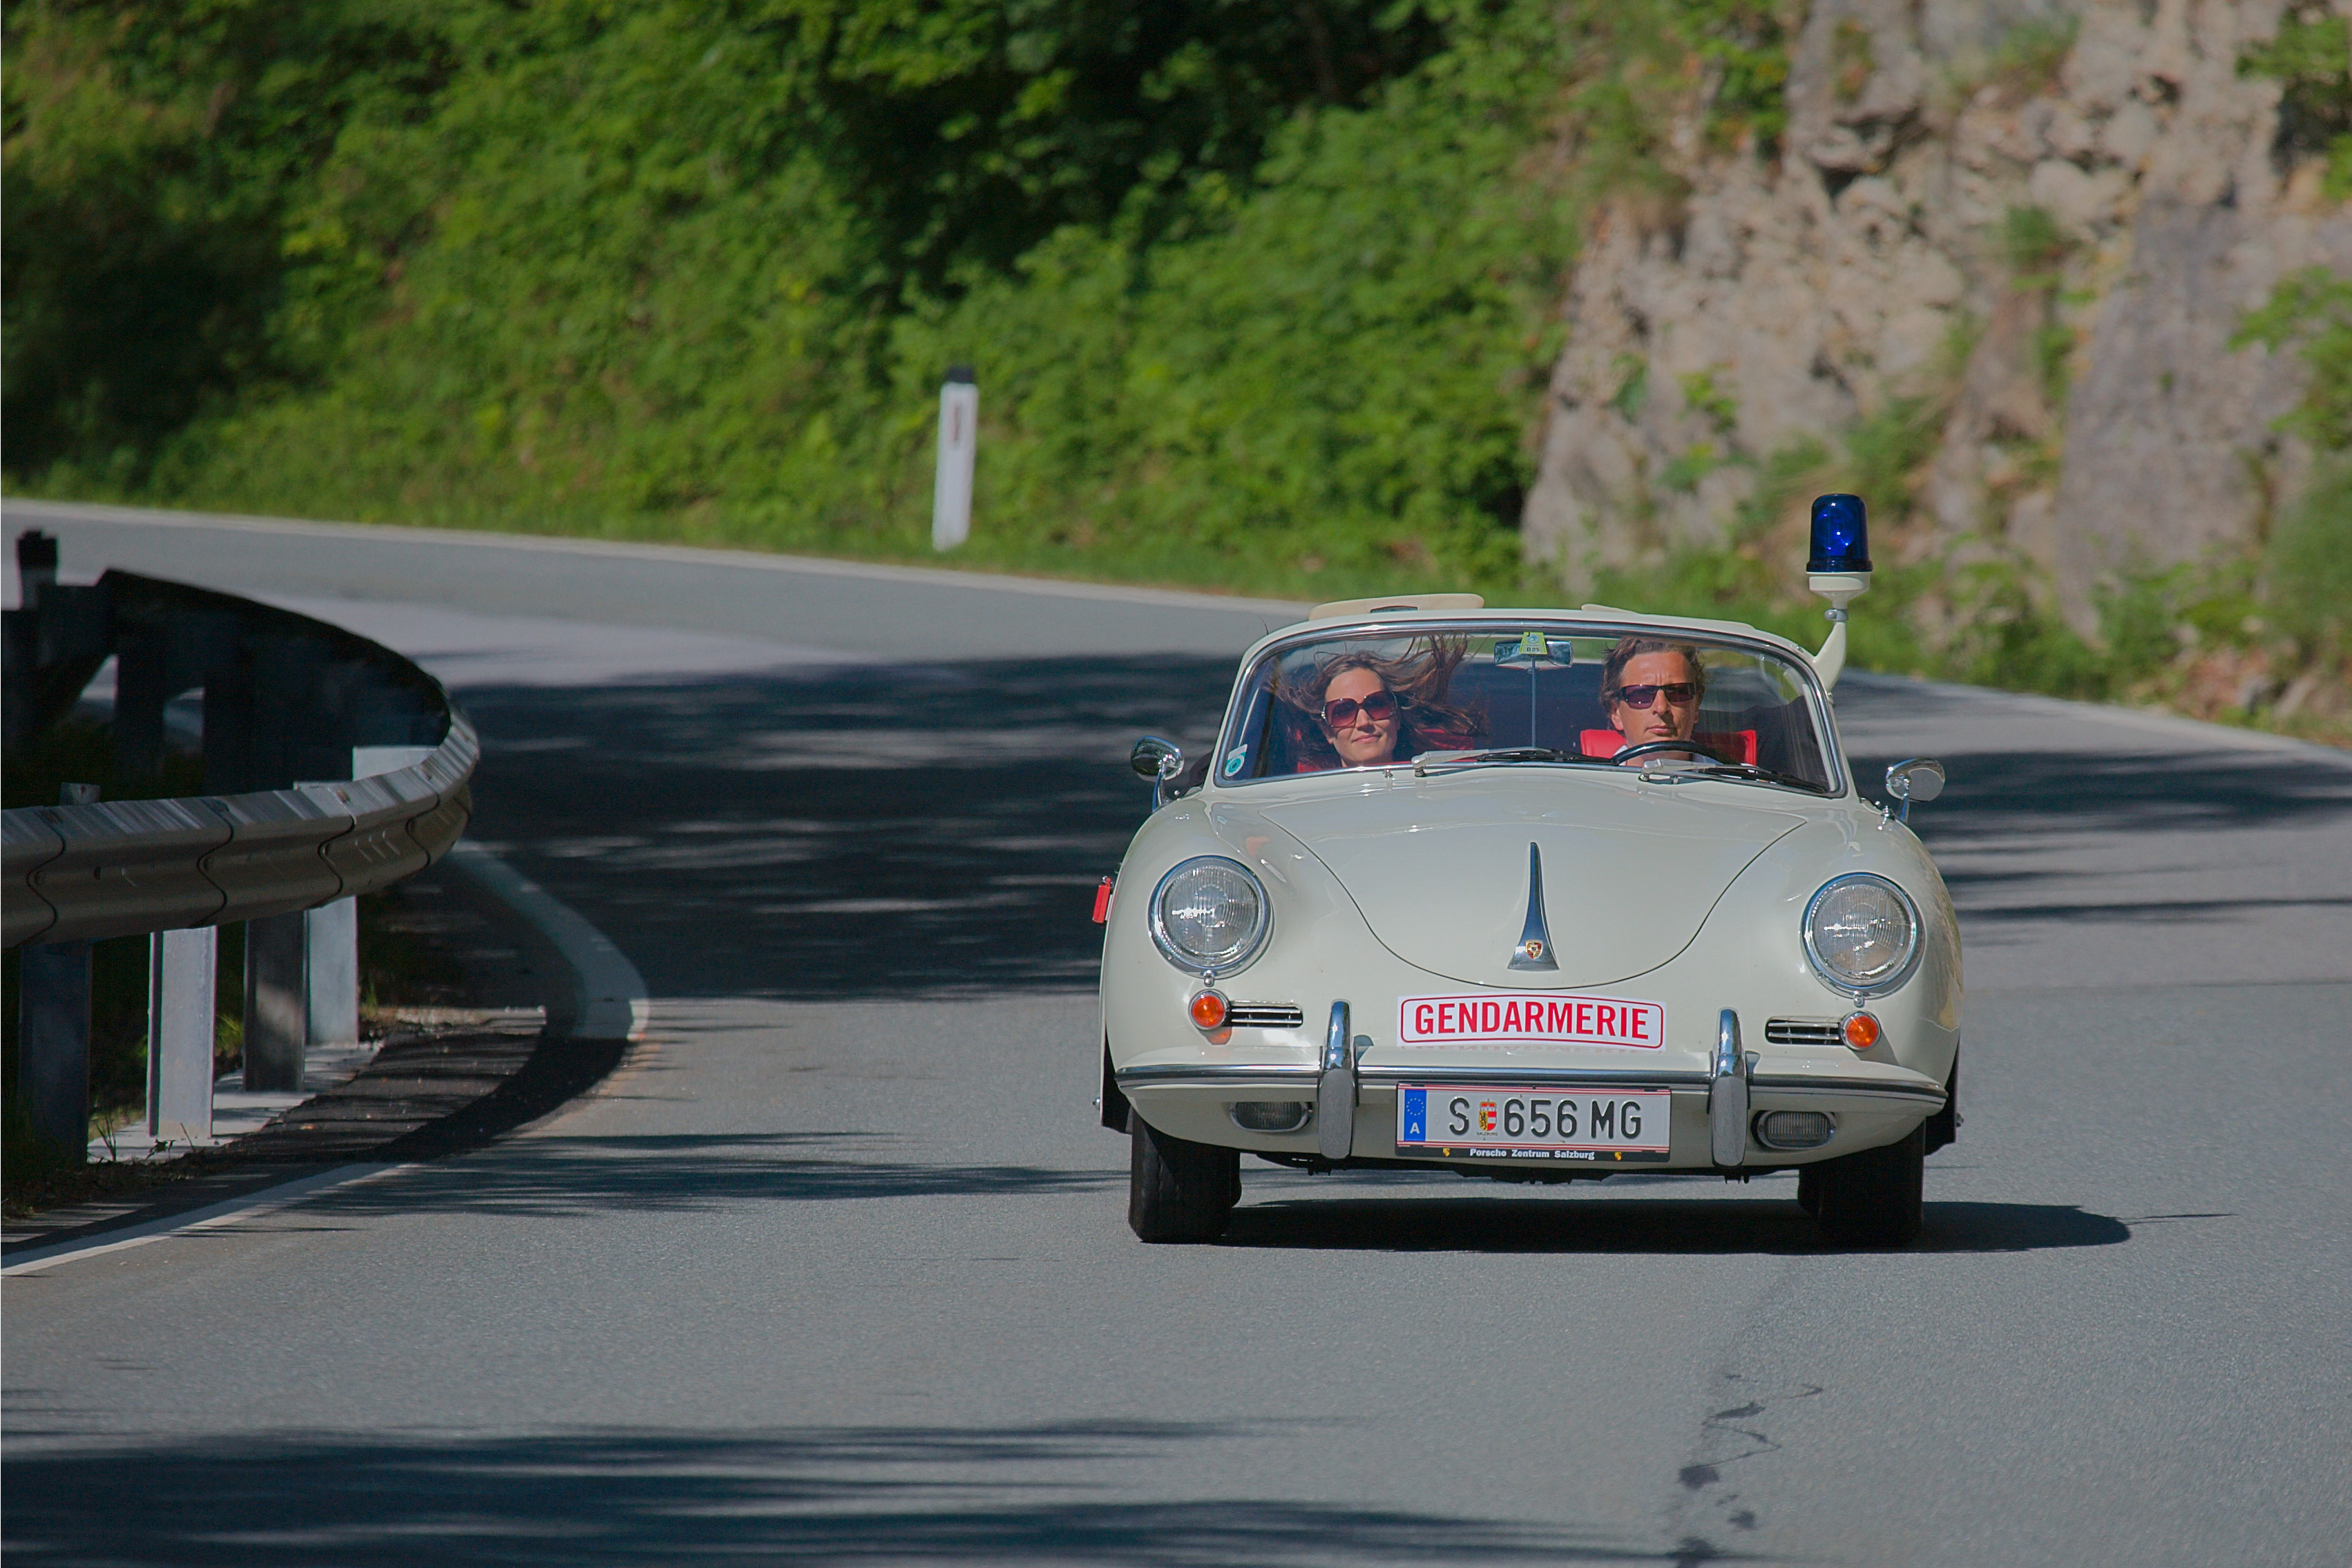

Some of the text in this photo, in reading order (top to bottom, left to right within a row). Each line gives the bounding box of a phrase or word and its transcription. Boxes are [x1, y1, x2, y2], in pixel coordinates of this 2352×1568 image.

[1415, 1001, 1649, 1040] GENDARMERIE
[1410, 1122, 1420, 1134] A
[1449, 1097, 1641, 1139] S 656 MG
[1470, 1148, 1595, 1160] Porsche Zentrum Salzburg
